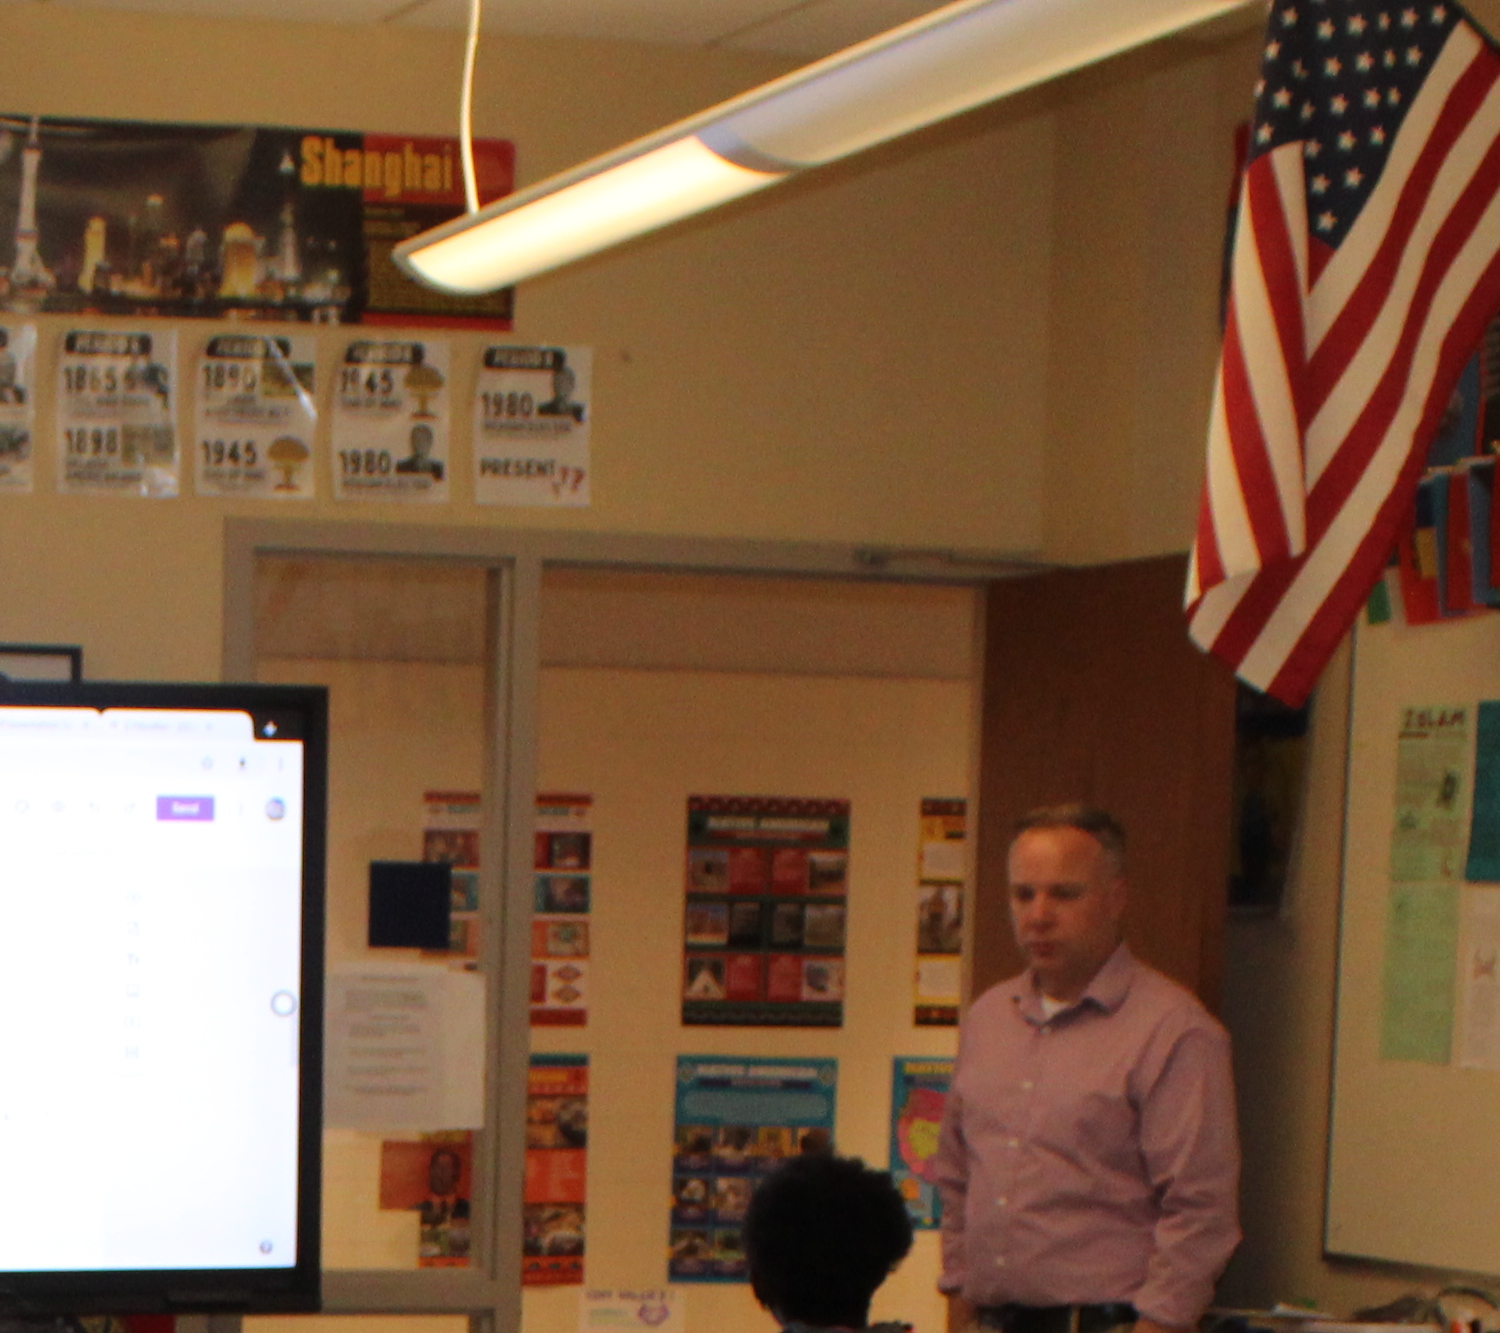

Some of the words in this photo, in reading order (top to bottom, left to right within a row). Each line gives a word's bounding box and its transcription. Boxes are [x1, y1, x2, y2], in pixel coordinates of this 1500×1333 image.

[302, 135, 454, 198] Shanghai
[482, 393, 533, 416] 1980
[66, 428, 117, 454] 1898
[203, 440, 257, 466] 1945
[339, 450, 391, 475] 1980
[481, 458, 555, 477] PRESENT
[171, 800, 200, 816] Send
